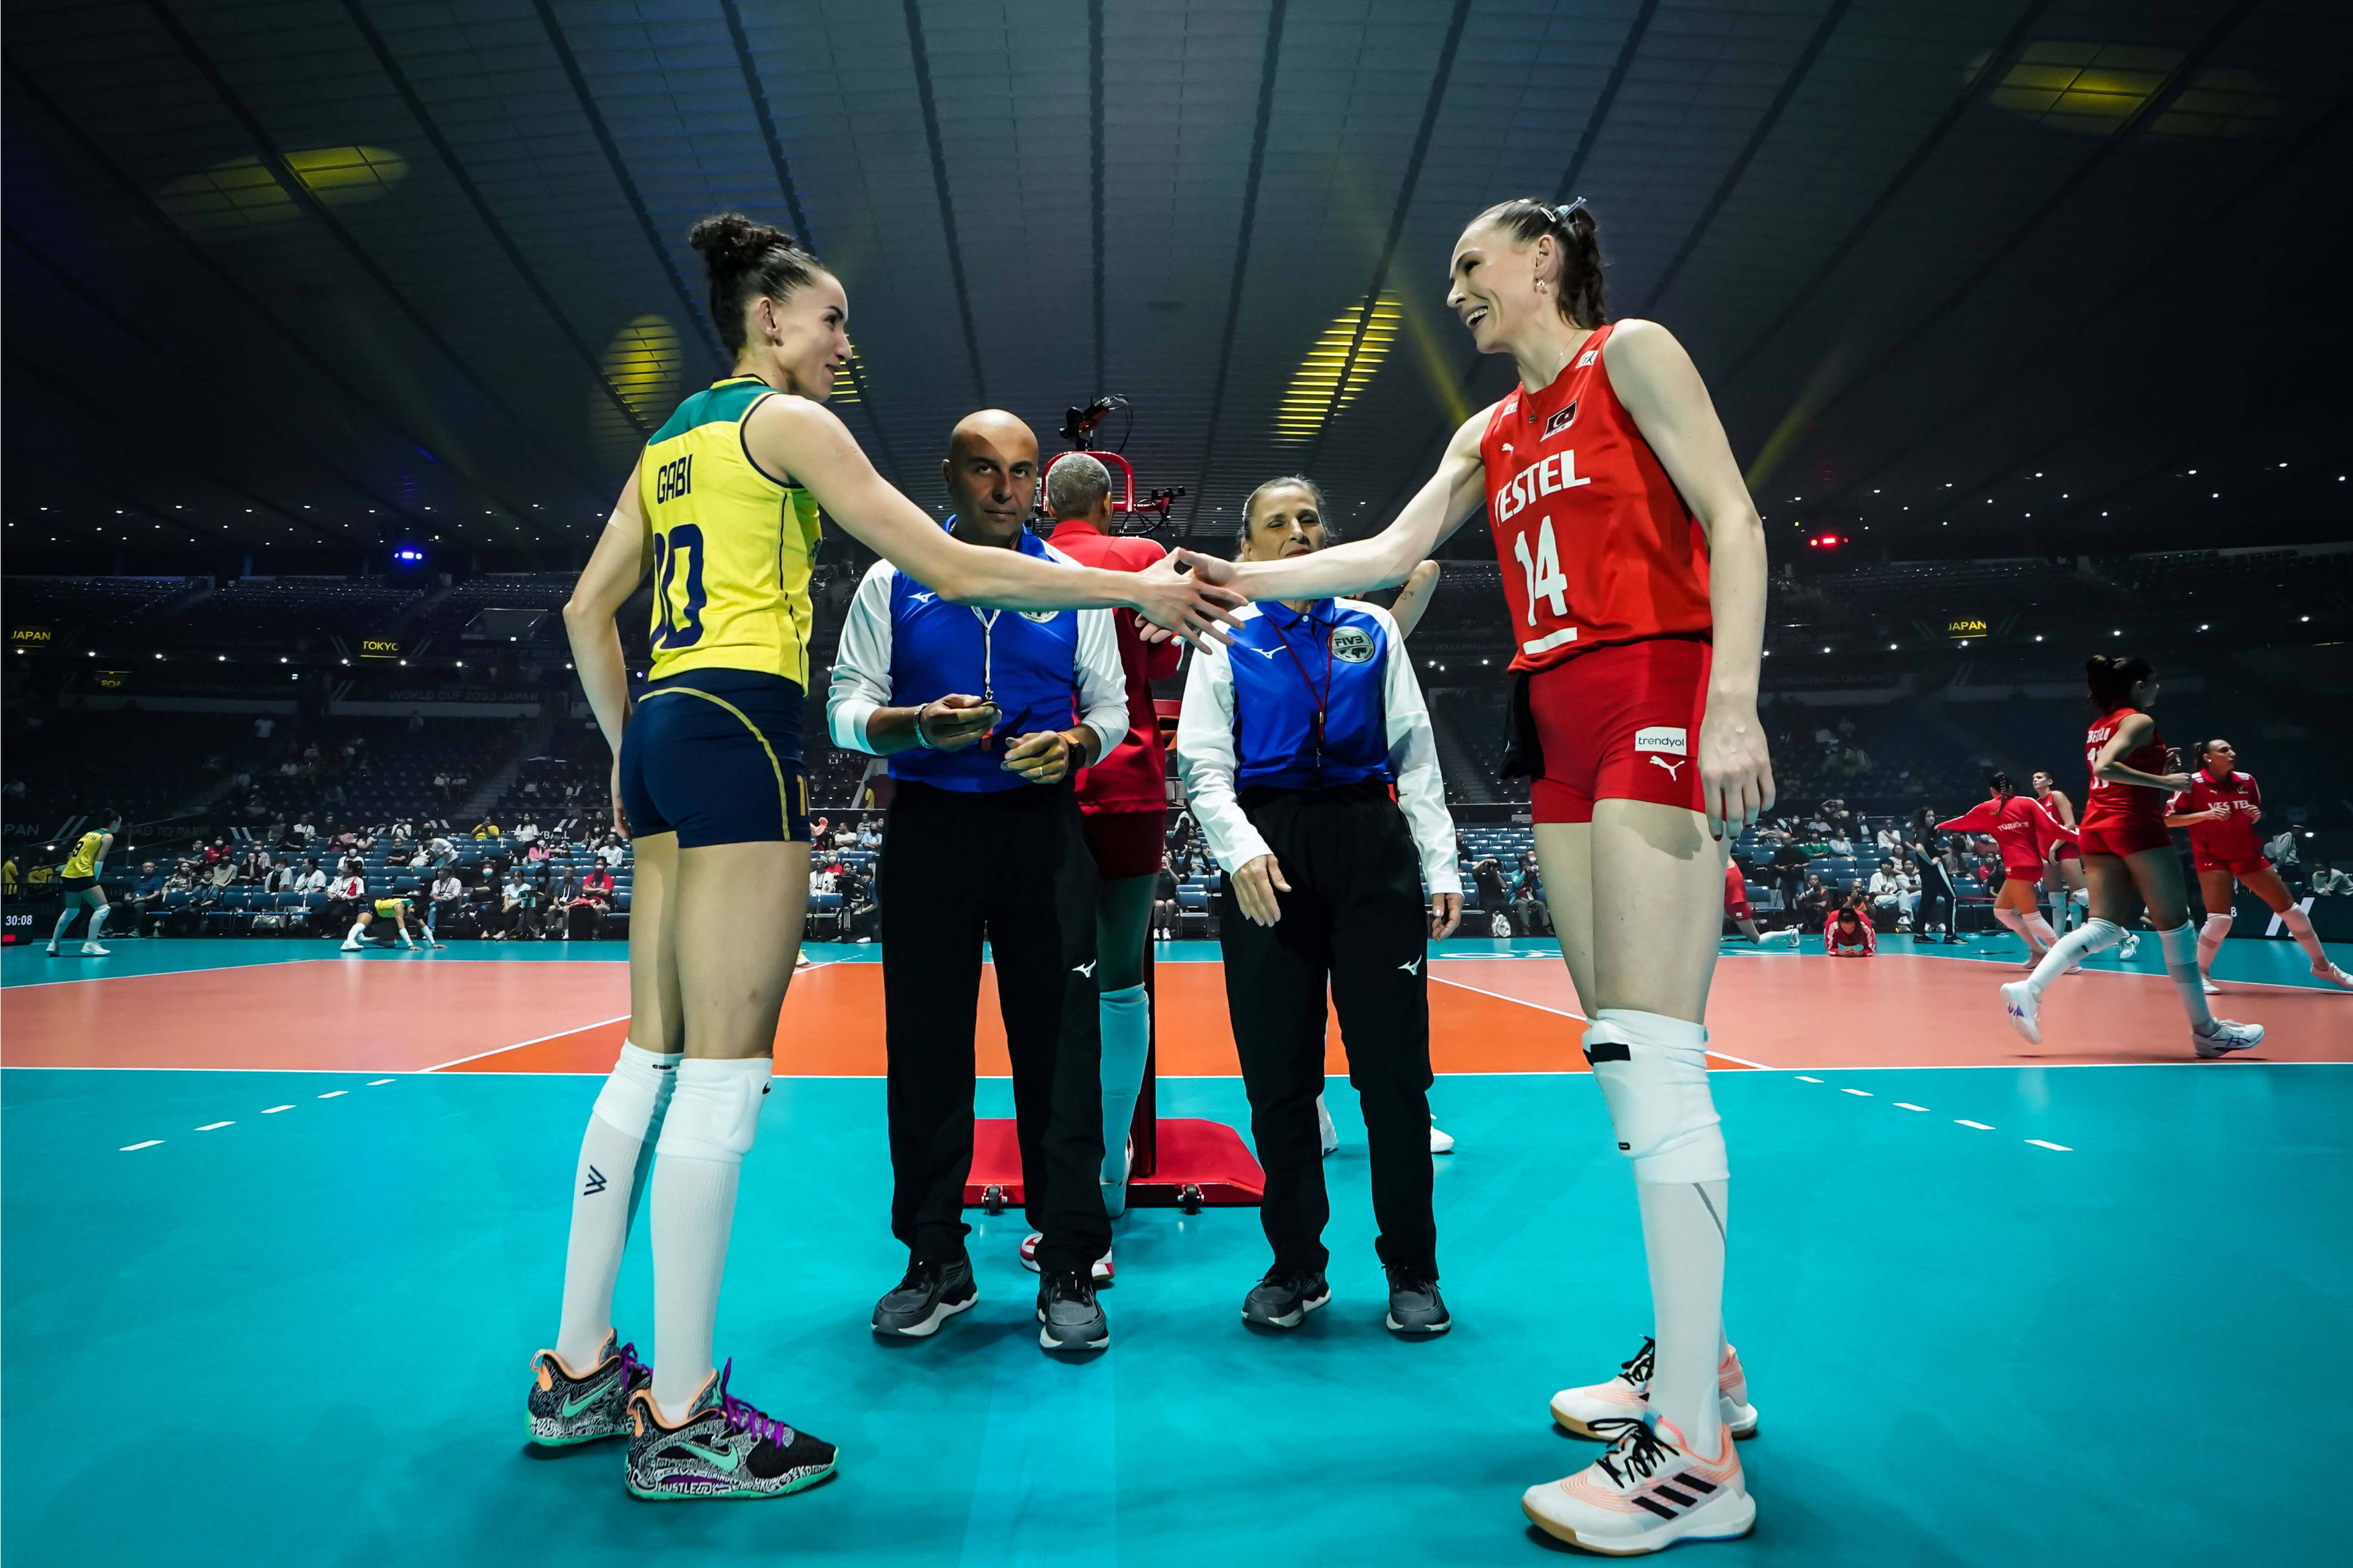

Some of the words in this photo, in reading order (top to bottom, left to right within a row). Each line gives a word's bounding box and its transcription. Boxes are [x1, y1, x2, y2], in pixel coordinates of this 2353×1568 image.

[657, 454, 692, 504] GABI
[1514, 515, 1568, 627] 14
[1947, 620, 1987, 631] JAPAN
[10, 631, 51, 640] JAPAN
[1333, 635, 1364, 647] FIVB
[1638, 737, 1684, 747] trendyol
[6, 915, 32, 926] 30:08
